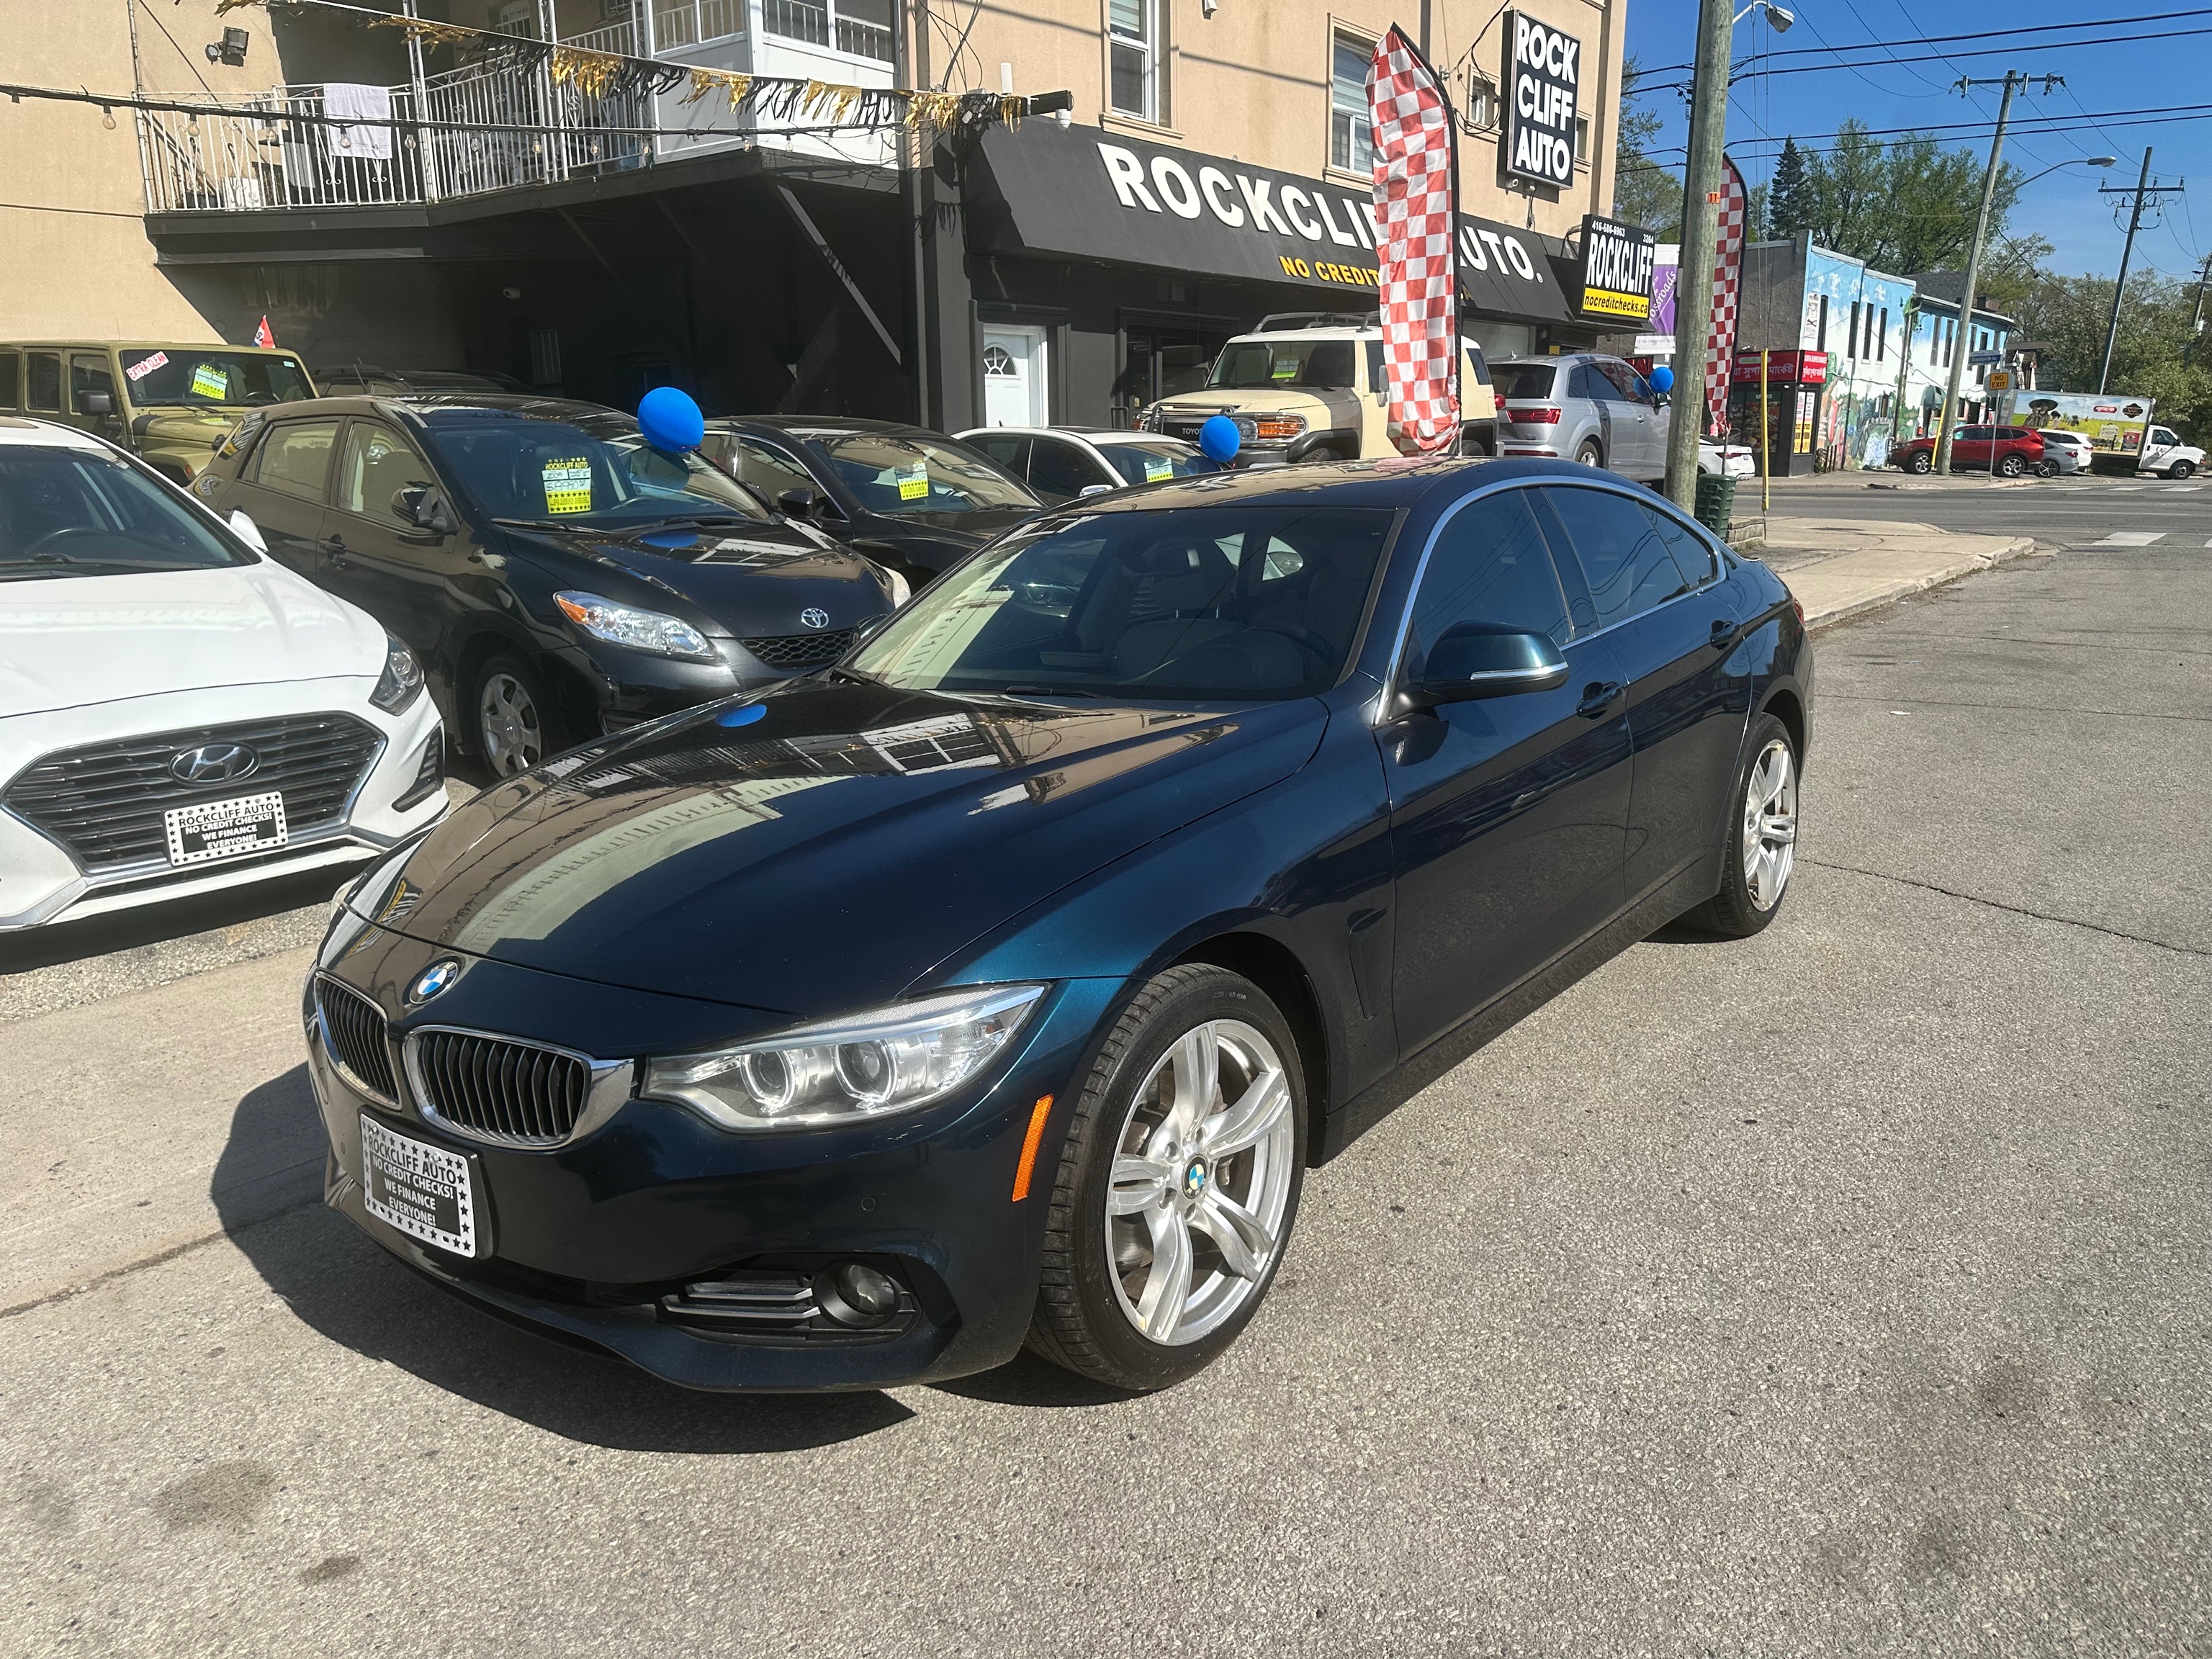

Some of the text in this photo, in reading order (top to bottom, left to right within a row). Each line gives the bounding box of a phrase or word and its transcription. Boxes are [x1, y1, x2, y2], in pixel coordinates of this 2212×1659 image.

[1516, 16, 1578, 84] ROCK
[1518, 73, 1573, 131] CLIFF
[1515, 126, 1570, 180] AUTO
[1592, 220, 1654, 244] 416-686-6963 3264
[1279, 256, 1310, 278] NO
[1315, 261, 1381, 287] CREDIT
[1586, 233, 1653, 295] ROCKCLIFF
[1584, 295, 1648, 314] nocreditchecks.ca
[1649, 271, 1676, 321] ossroads
[127, 354, 167, 379] EXTRA CLEAN
[545, 461, 588, 470] ROCKCLIFF AUTO
[179, 803, 274, 827] ROCKCLIFF AUTO
[185, 812, 272, 835] NO CREDIT CHECKS!
[202, 824, 257, 841] WE FINANCE
[207, 835, 257, 850] EVERYONE!
[368, 1136, 457, 1184] ROCKCLIFF AUTO
[372, 1156, 454, 1200] NO CREDIT CHECKS!
[385, 1177, 436, 1210] WE FINANCE
[388, 1195, 436, 1227] EVERYONE!
